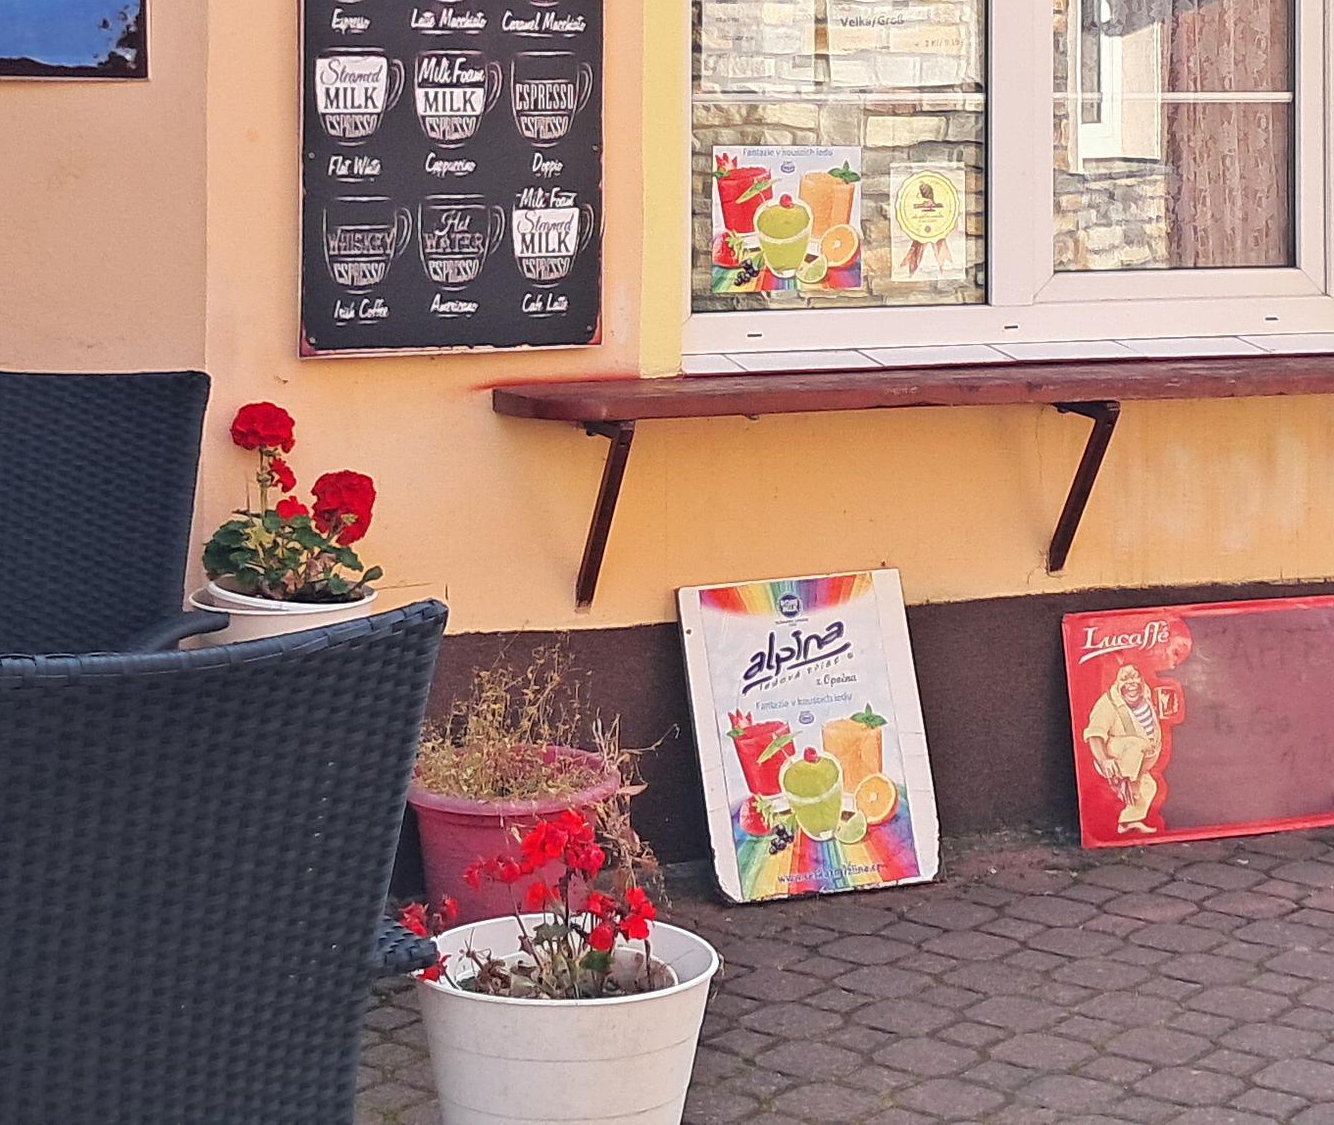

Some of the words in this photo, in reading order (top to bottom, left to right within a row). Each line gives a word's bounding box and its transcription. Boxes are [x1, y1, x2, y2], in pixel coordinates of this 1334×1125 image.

[319, 58, 384, 86] Steamed
[418, 57, 451, 84] Milk
[452, 57, 486, 85] Foam
[323, 86, 380, 110] MILK
[422, 89, 478, 114] MILK
[516, 83, 575, 111] ESPRESSO
[325, 114, 379, 138] ESPRESSO
[425, 116, 477, 141] ESPRESSO
[520, 115, 569, 140] ESPRESSO
[327, 227, 396, 256] WHISKEY
[423, 232, 484, 255] WATER
[520, 232, 572, 255] MILK
[333, 262, 386, 286] ESPRESSO
[428, 259, 480, 284] ESPRESSO
[521, 257, 571, 281] ESPRESSO
[1082, 620, 1170, 651] Lucaffé
[743, 621, 844, 681] alpina
